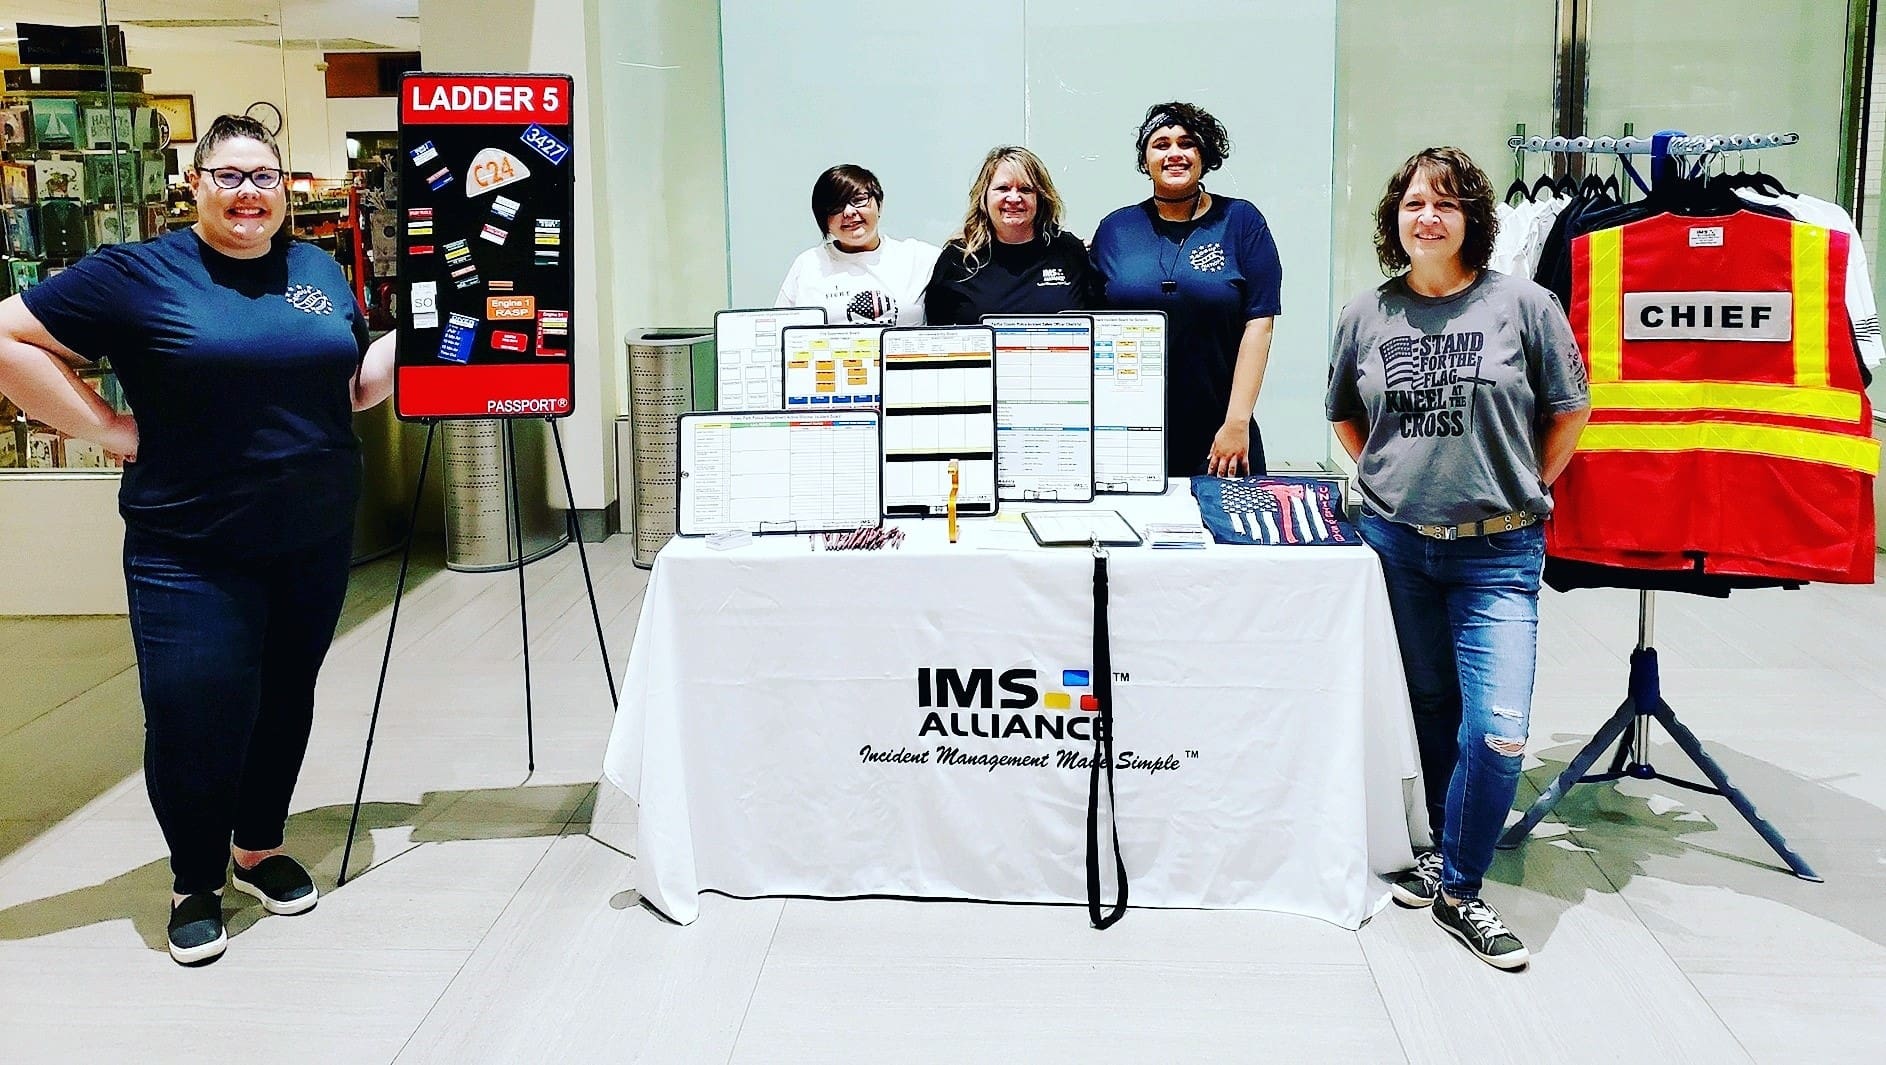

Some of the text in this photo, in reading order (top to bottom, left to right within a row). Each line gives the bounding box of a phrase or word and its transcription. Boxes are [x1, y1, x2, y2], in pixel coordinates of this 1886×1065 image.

[412, 85, 559, 111] LADDER 5
[526, 128, 566, 156] 3427
[474, 156, 514, 187] C24
[415, 297, 432, 307] SO
[491, 300, 522, 308] Engine
[1640, 305, 1772, 329] CHIEF
[1420, 332, 1484, 356] STAND
[1420, 352, 1477, 372] FOR THE
[1423, 369, 1458, 388] FLAG
[1452, 385, 1464, 396] AT
[1385, 388, 1447, 413] KNEEL
[1449, 396, 1467, 407] THE
[1400, 411, 1464, 438] CROSS
[917, 667, 1130, 709] IMS TM
[859, 744, 929, 764] Incident
[936, 745, 1048, 772] Management
[1114, 751, 1180, 775] Simple
[1185, 750, 1198, 758] TM
